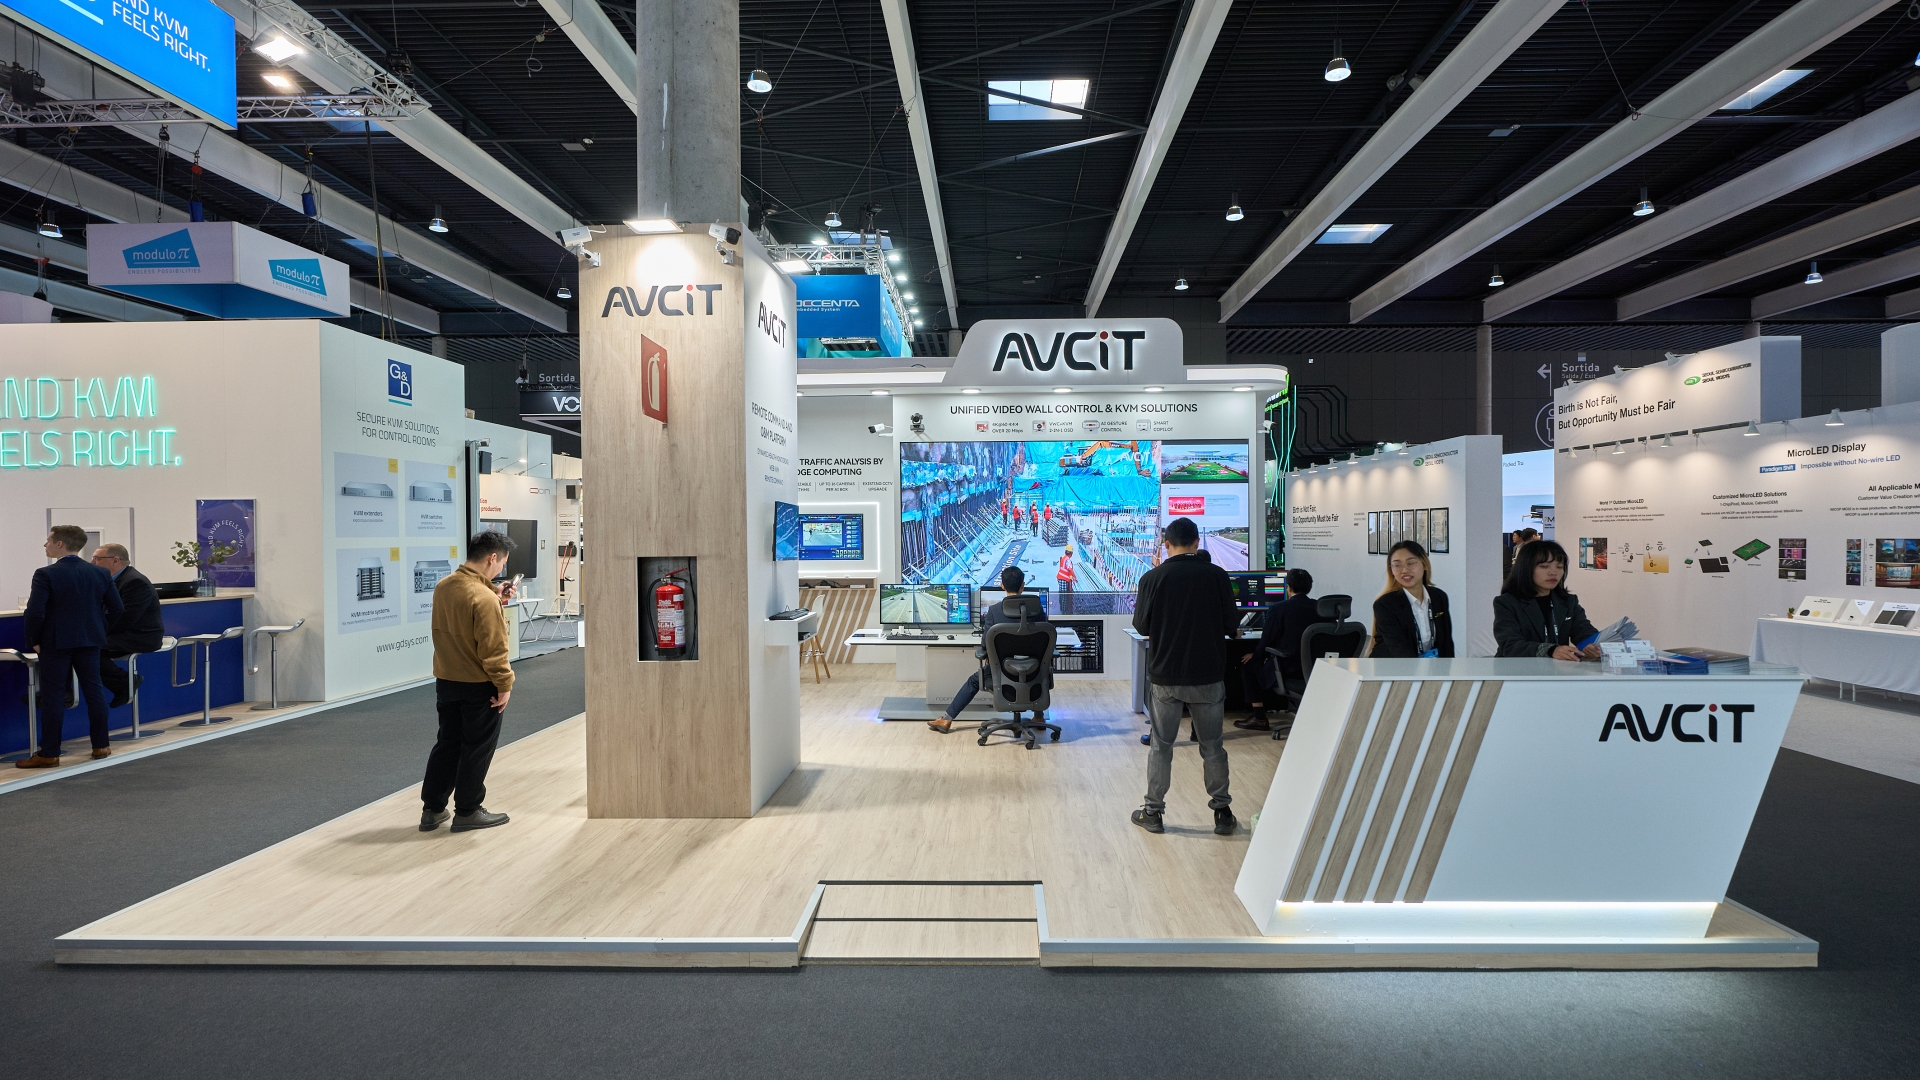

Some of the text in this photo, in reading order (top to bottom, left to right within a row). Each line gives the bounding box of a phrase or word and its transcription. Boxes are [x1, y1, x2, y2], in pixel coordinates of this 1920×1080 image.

[121, 0, 189, 41] ND KVM
[112, 1, 211, 72] FEELS RIGHT.
[133, 249, 176, 260] modulo
[276, 263, 310, 282] modulo
[1561, 362, 1600, 372] Sortida
[538, 373, 576, 382] Sortida
[0, 376, 155, 418] ND KVM
[552, 396, 582, 412] VO
[1558, 393, 1618, 415] Birth is Not Fair,
[751, 401, 768, 420] REMOTE
[950, 403, 1198, 414] UNIFIED VIDEO WALL CONTROL & KVM SOLUTIONS
[1558, 398, 1676, 430] But Opportunity Must be Fair
[356, 411, 440, 435] SECURE KVM SOLUTIONS
[361, 427, 437, 447] FOR CONTROL ROOMS
[72, 426, 182, 467] RIGHT.
[1787, 442, 1867, 458] MicroLED Display
[799, 457, 884, 466] TRAFFIC ANALYSIS BY
[1800, 461, 1832, 470] Impossible
[1833, 458, 1857, 466] without
[1858, 456, 1884, 464] No-wire
[1885, 454, 1901, 462] LED
[813, 468, 862, 476] COMPUTING
[1878, 483, 1913, 492] Applicable
[481, 505, 501, 513] productive
[376, 635, 429, 653] www.gdsys.com
